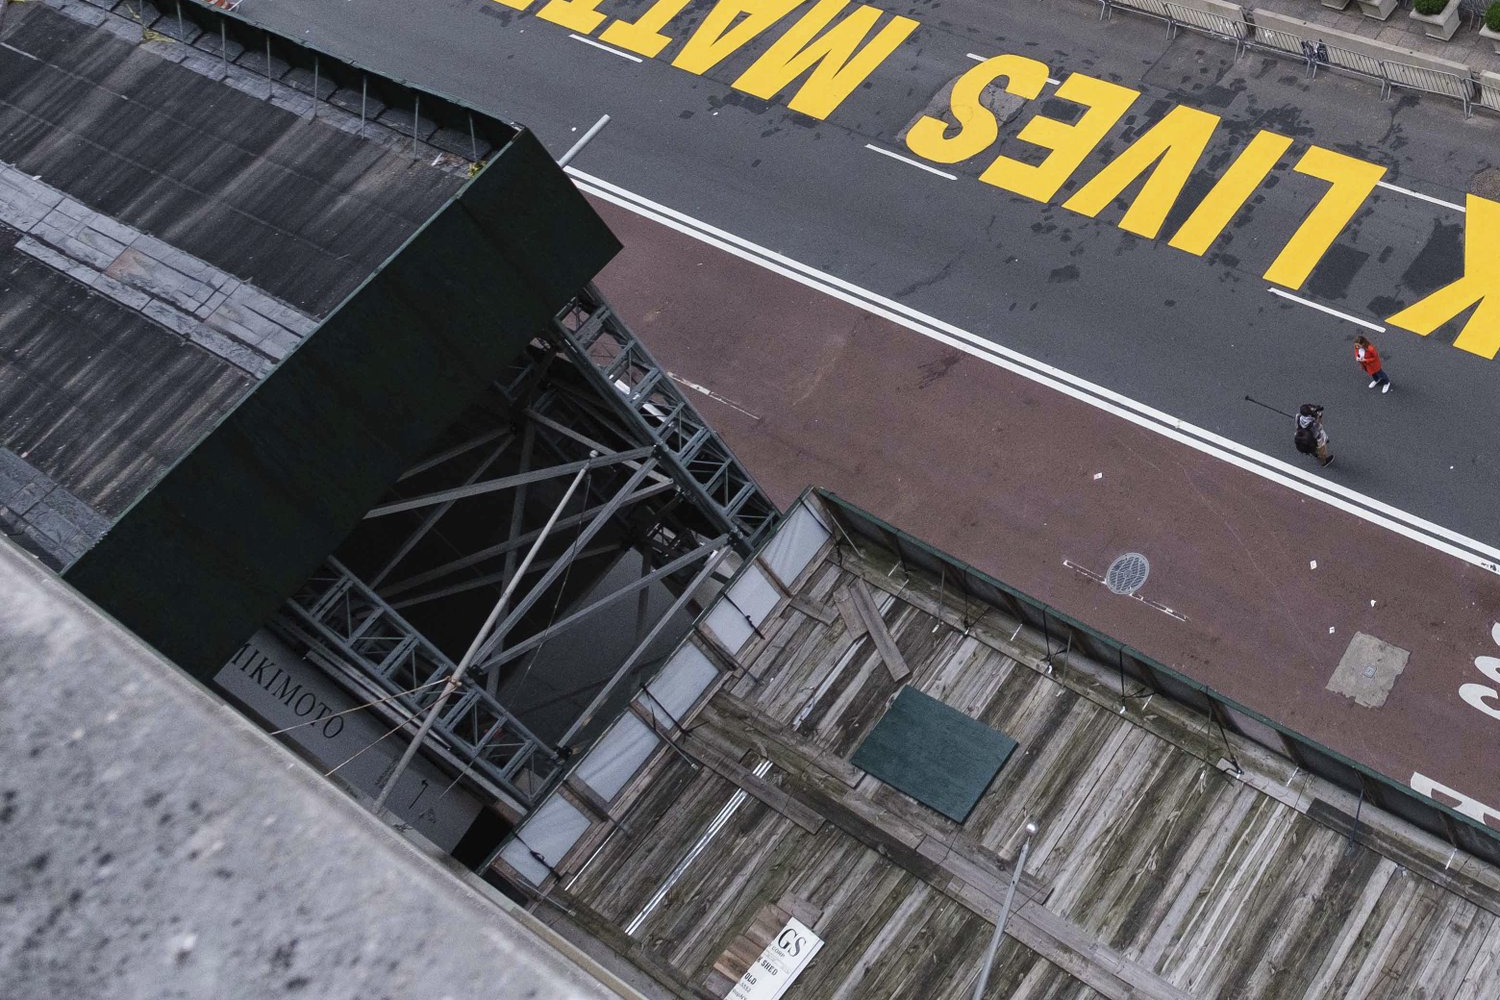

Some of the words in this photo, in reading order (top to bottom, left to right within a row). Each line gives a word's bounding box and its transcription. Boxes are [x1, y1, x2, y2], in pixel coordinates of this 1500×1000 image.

[907, 56, 1385, 291] LIVES
[761, 959, 778, 976] SHED
[744, 972, 758, 985] OLD
